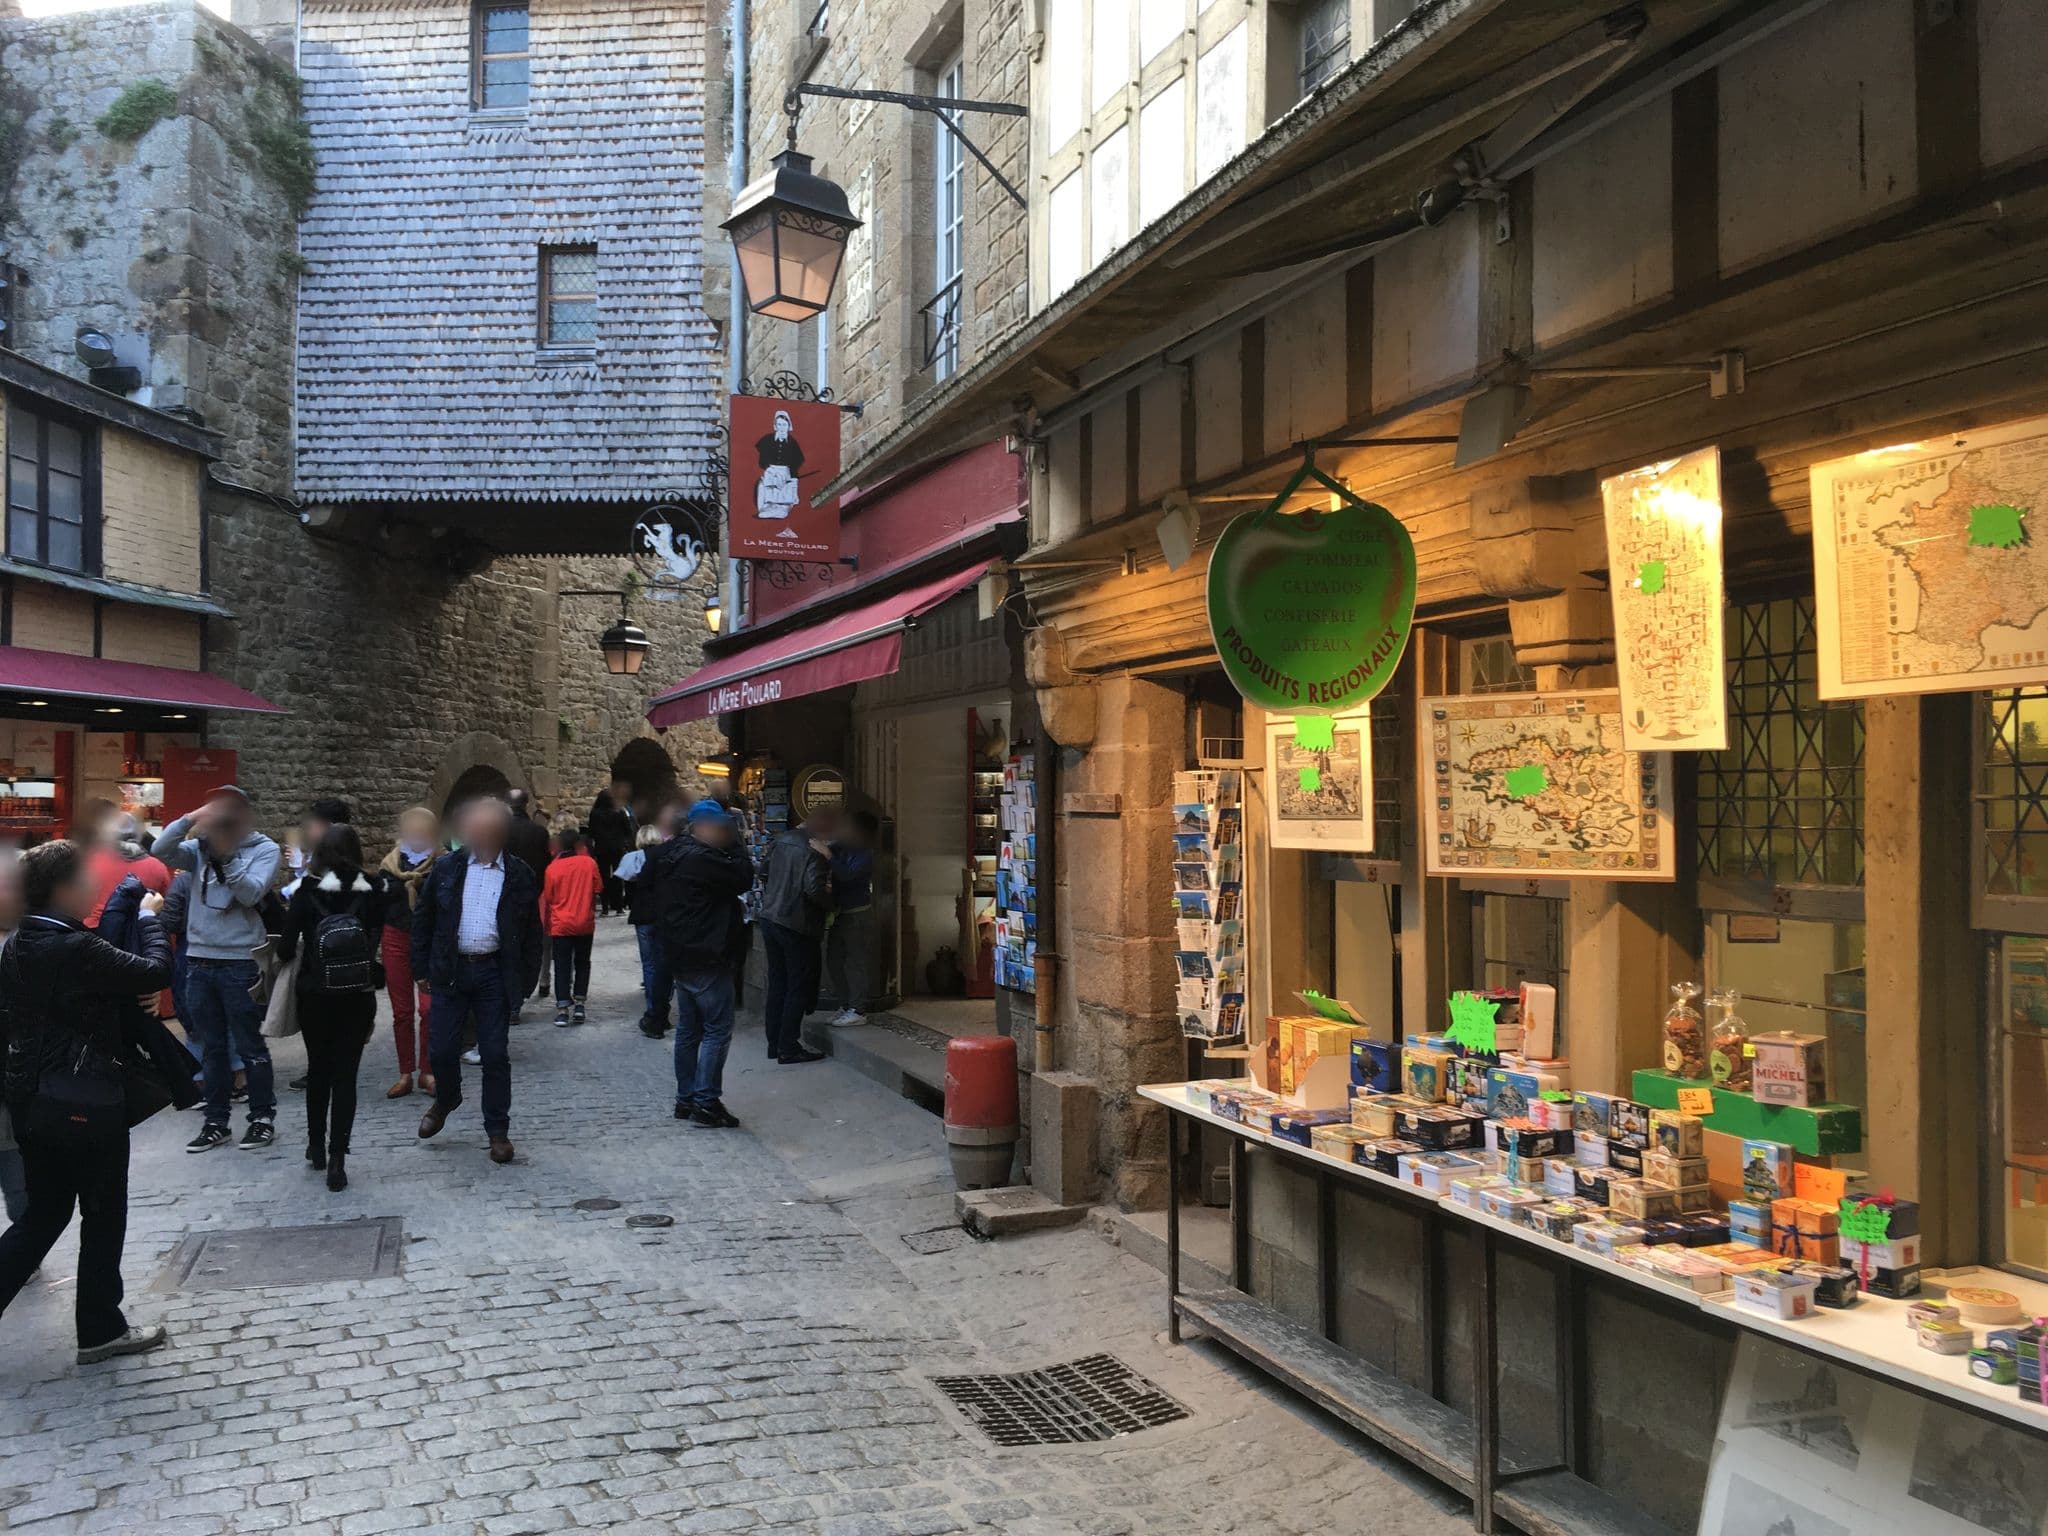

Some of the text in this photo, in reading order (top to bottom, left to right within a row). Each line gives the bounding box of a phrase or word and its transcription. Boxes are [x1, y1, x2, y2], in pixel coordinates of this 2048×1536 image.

[1281, 579, 1363, 594] CALVADOS
[1264, 608, 1357, 623] CONFISERIE
[1223, 625, 1401, 703] PRODUITS REGIONAUX
[1756, 1068, 1804, 1082] MICHEL
